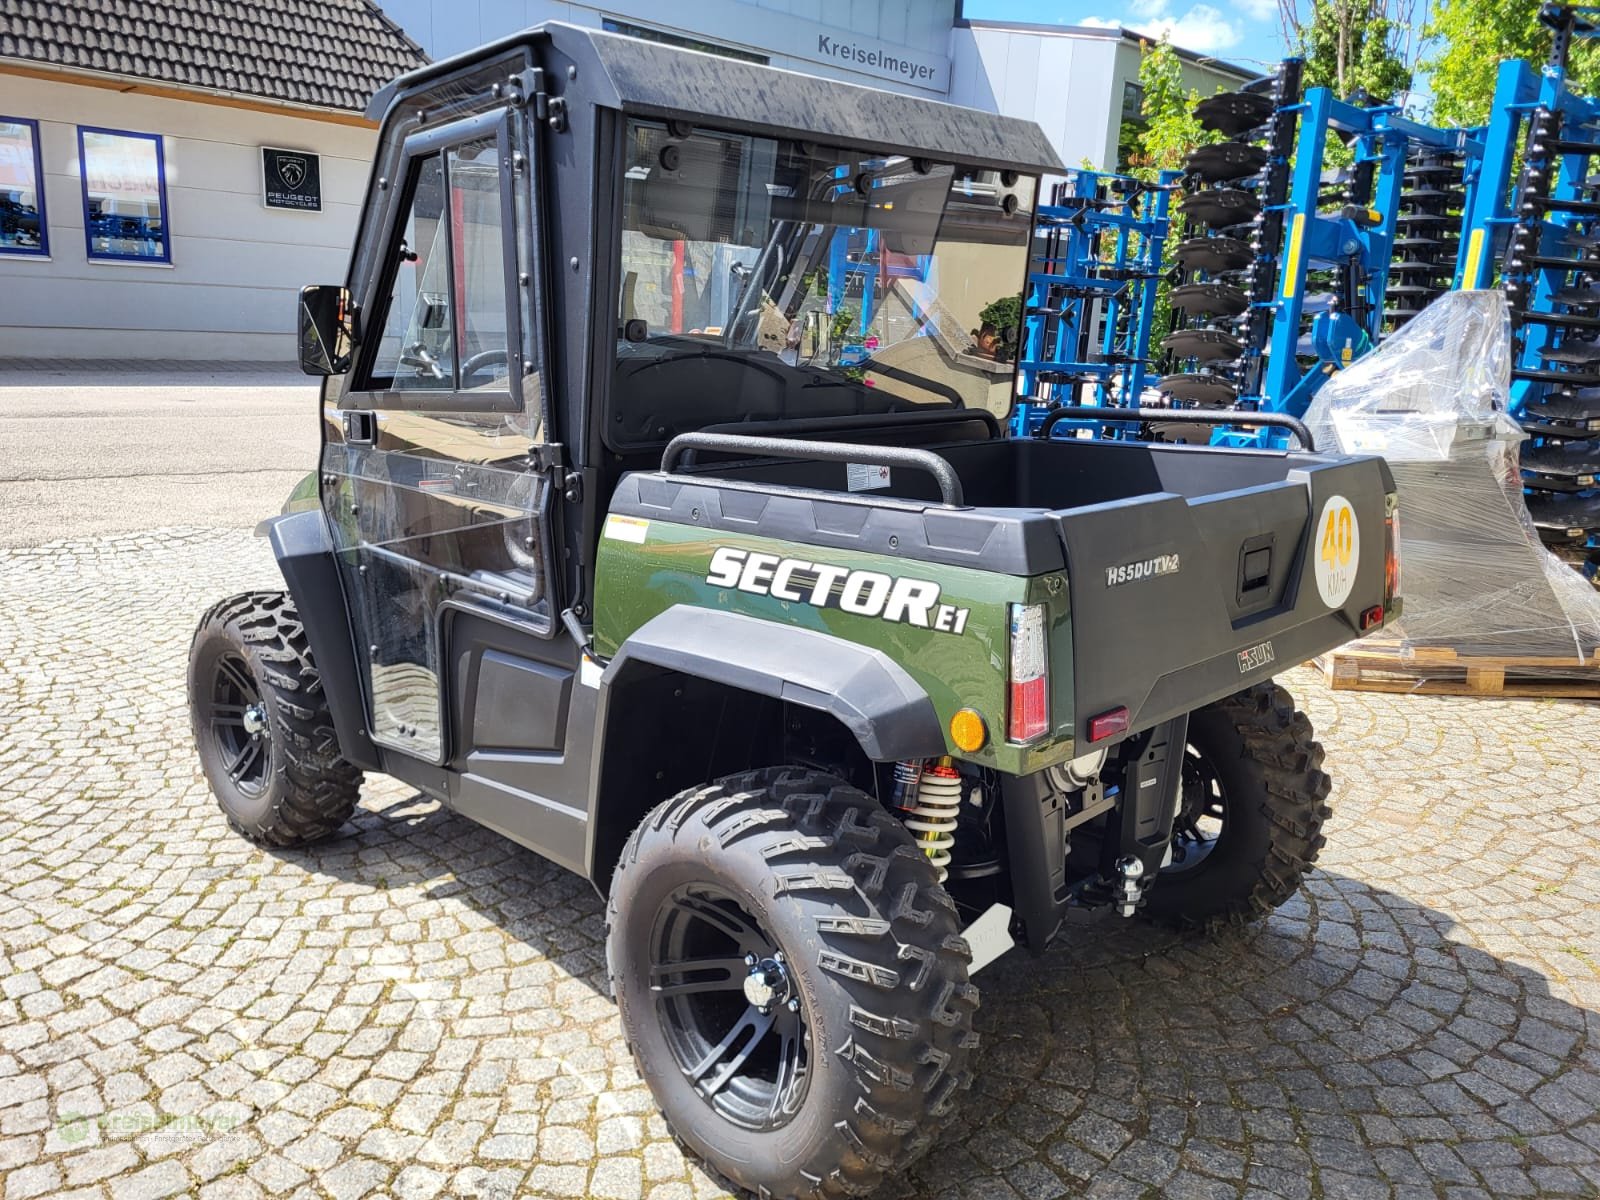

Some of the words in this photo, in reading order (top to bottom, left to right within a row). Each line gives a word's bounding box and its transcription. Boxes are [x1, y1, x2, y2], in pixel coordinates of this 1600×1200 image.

[818, 34, 936, 81] Kreiselmeyer
[267, 191, 318, 201] PEUGEOT
[1321, 506, 1352, 571] 40
[705, 547, 942, 628] SECTOR
[934, 605, 971, 636] E1
